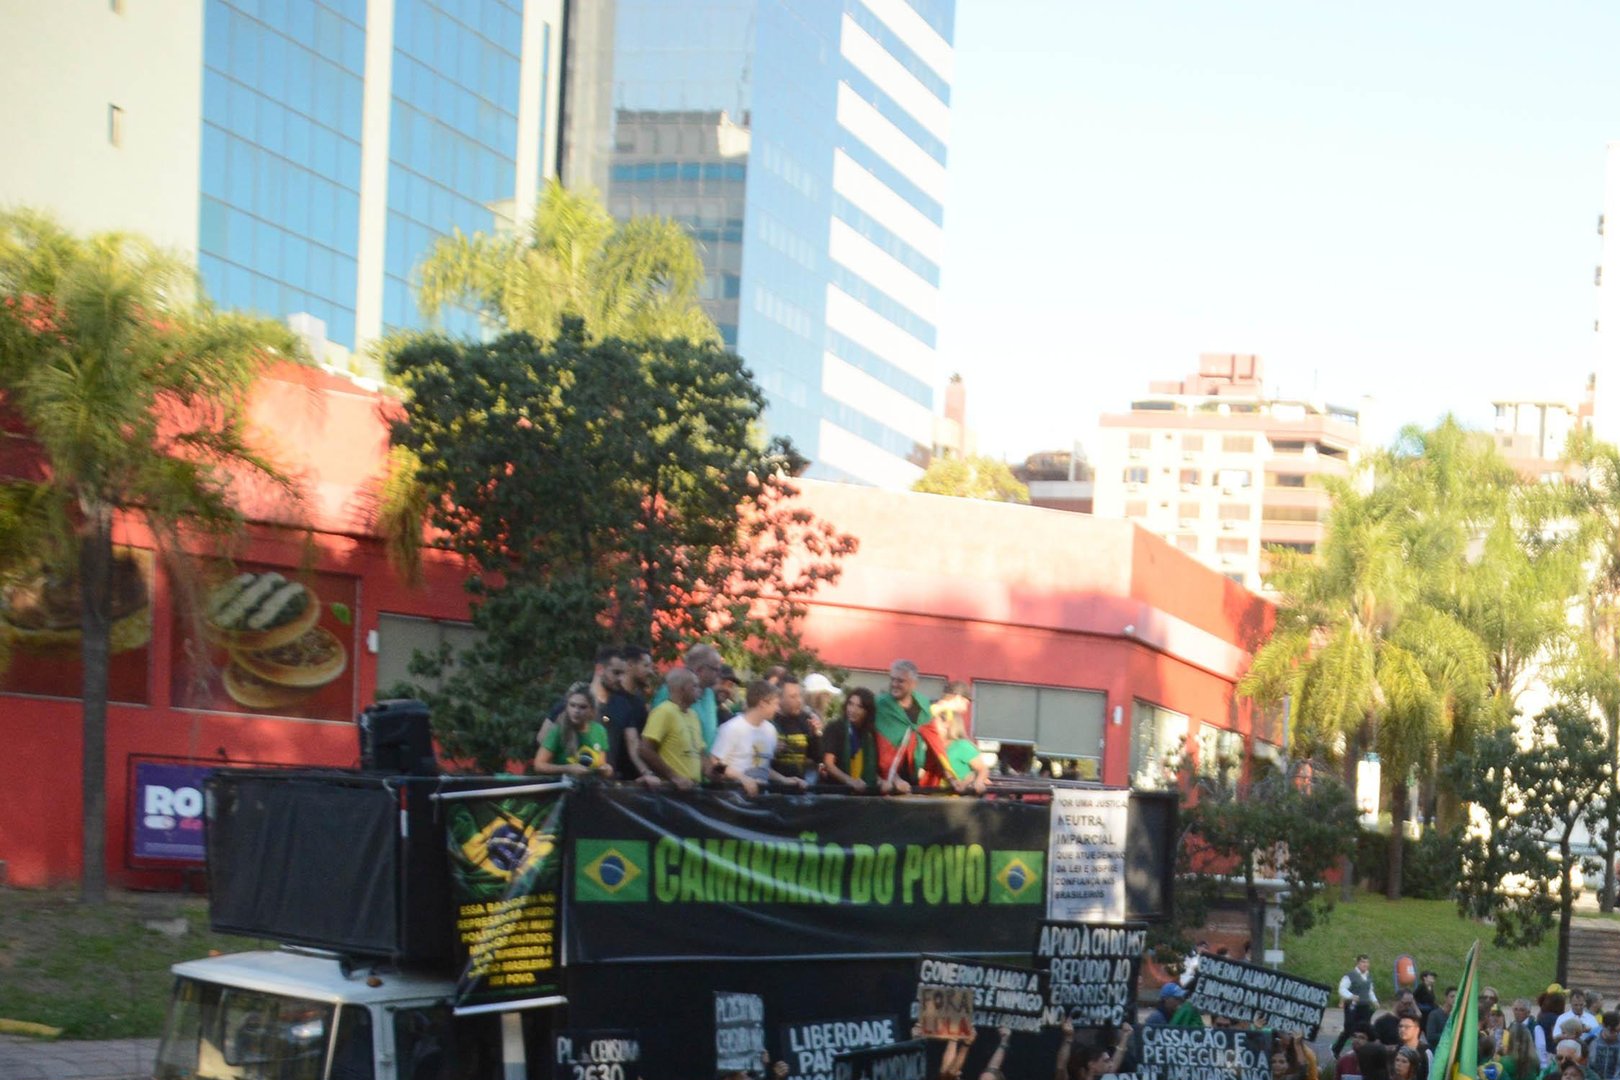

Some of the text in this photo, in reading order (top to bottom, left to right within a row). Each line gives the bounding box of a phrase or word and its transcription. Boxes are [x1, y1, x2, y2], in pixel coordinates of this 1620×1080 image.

[653, 831, 985, 904] CAMINHÃO DO POVO
[1039, 926, 1080, 956] APOIO
[921, 960, 984, 986] GOVERNO
[789, 1019, 895, 1052] LIBERDADE
[1142, 1026, 1247, 1051] CASSAÇÃO E
[557, 1036, 577, 1064] PL
[1257, 1050, 1269, 1070] A
